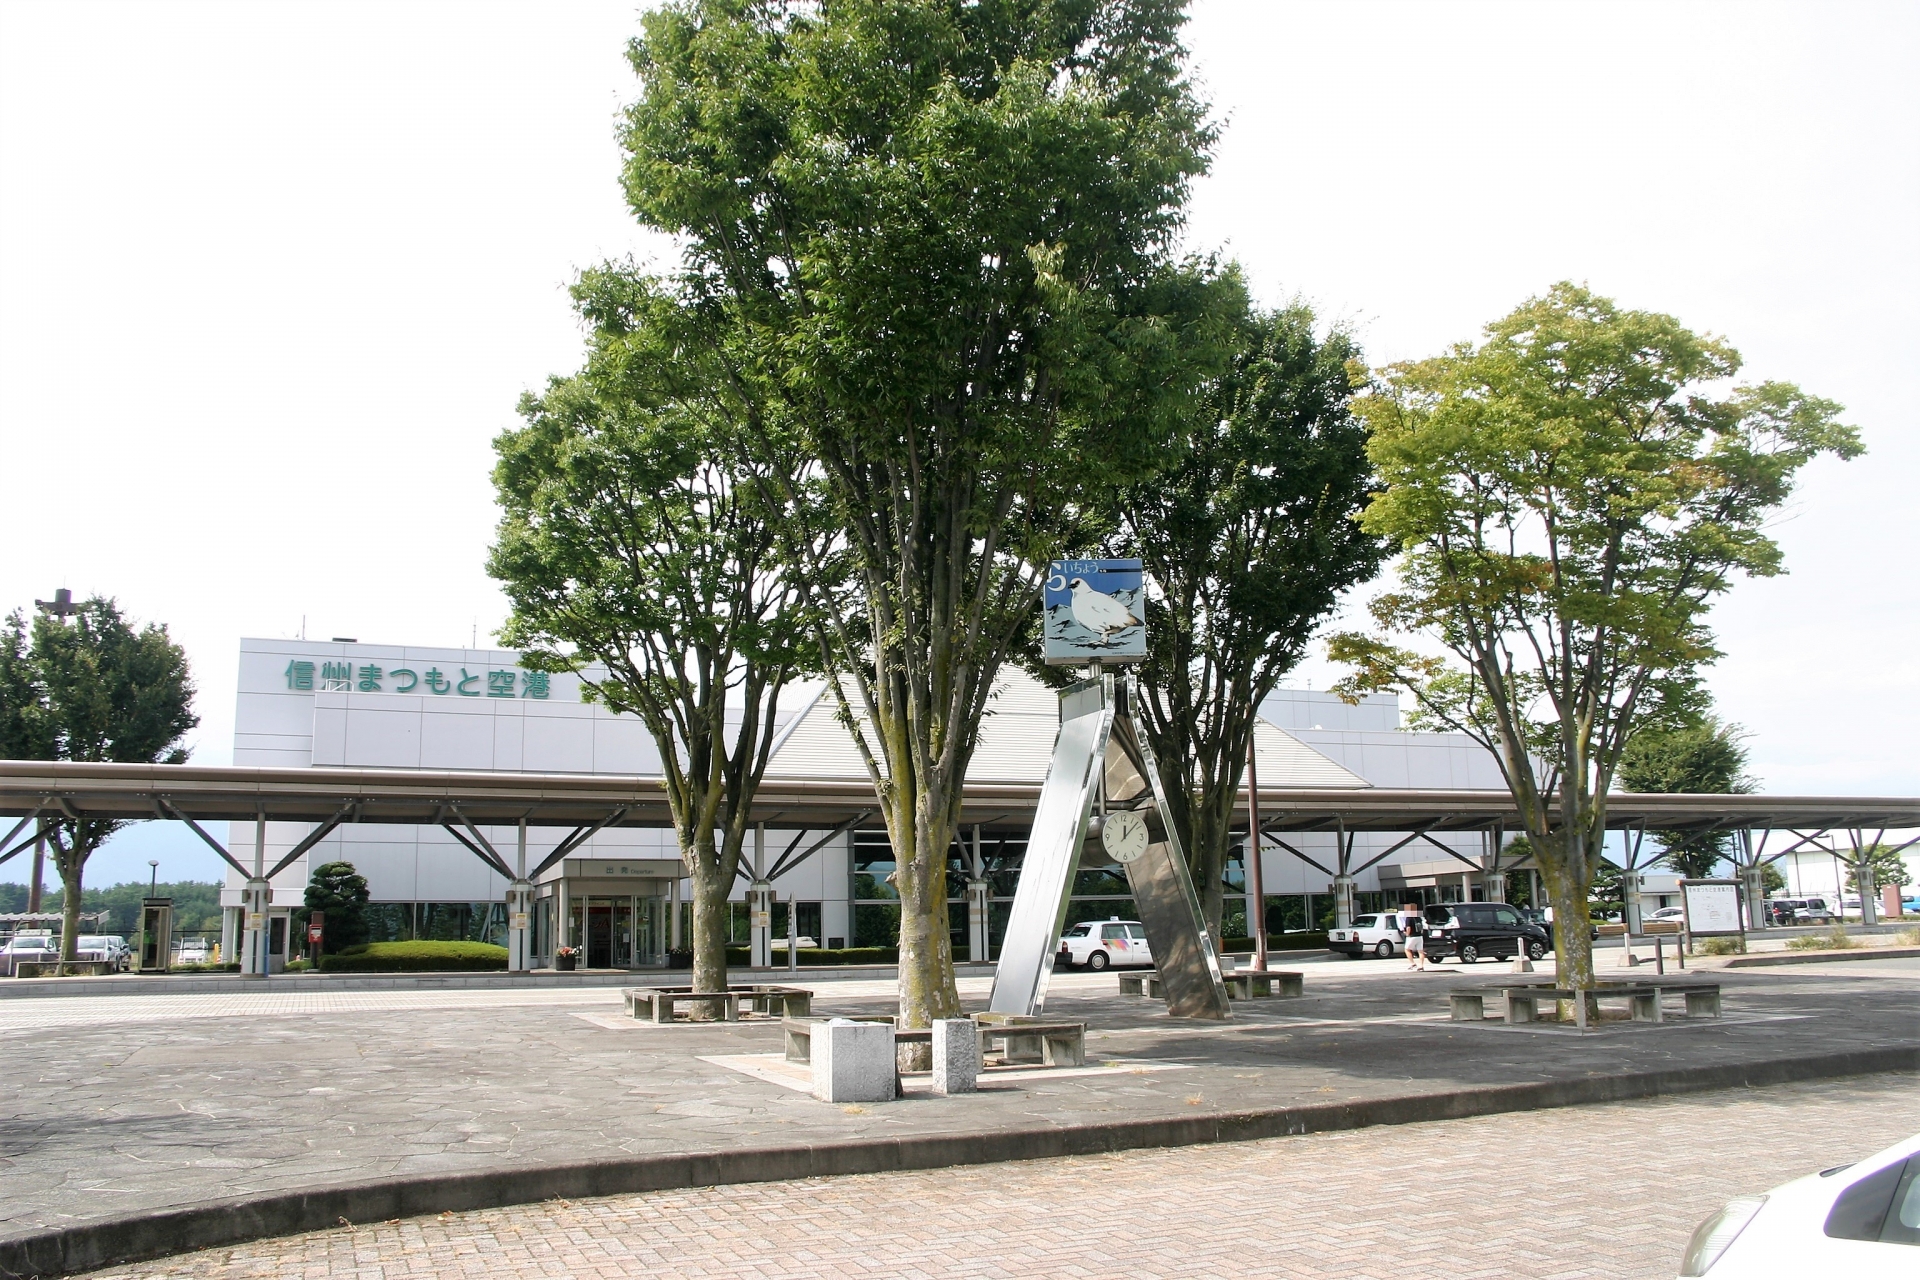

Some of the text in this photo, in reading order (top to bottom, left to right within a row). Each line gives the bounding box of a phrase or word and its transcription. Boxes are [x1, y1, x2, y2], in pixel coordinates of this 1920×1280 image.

[285, 659, 551, 699] 信州まつもと空港
[1120, 814, 1127, 822] 12
[1105, 833, 1110, 841] 9
[1139, 833, 1144, 841] 3
[1122, 852, 1128, 860] 6
